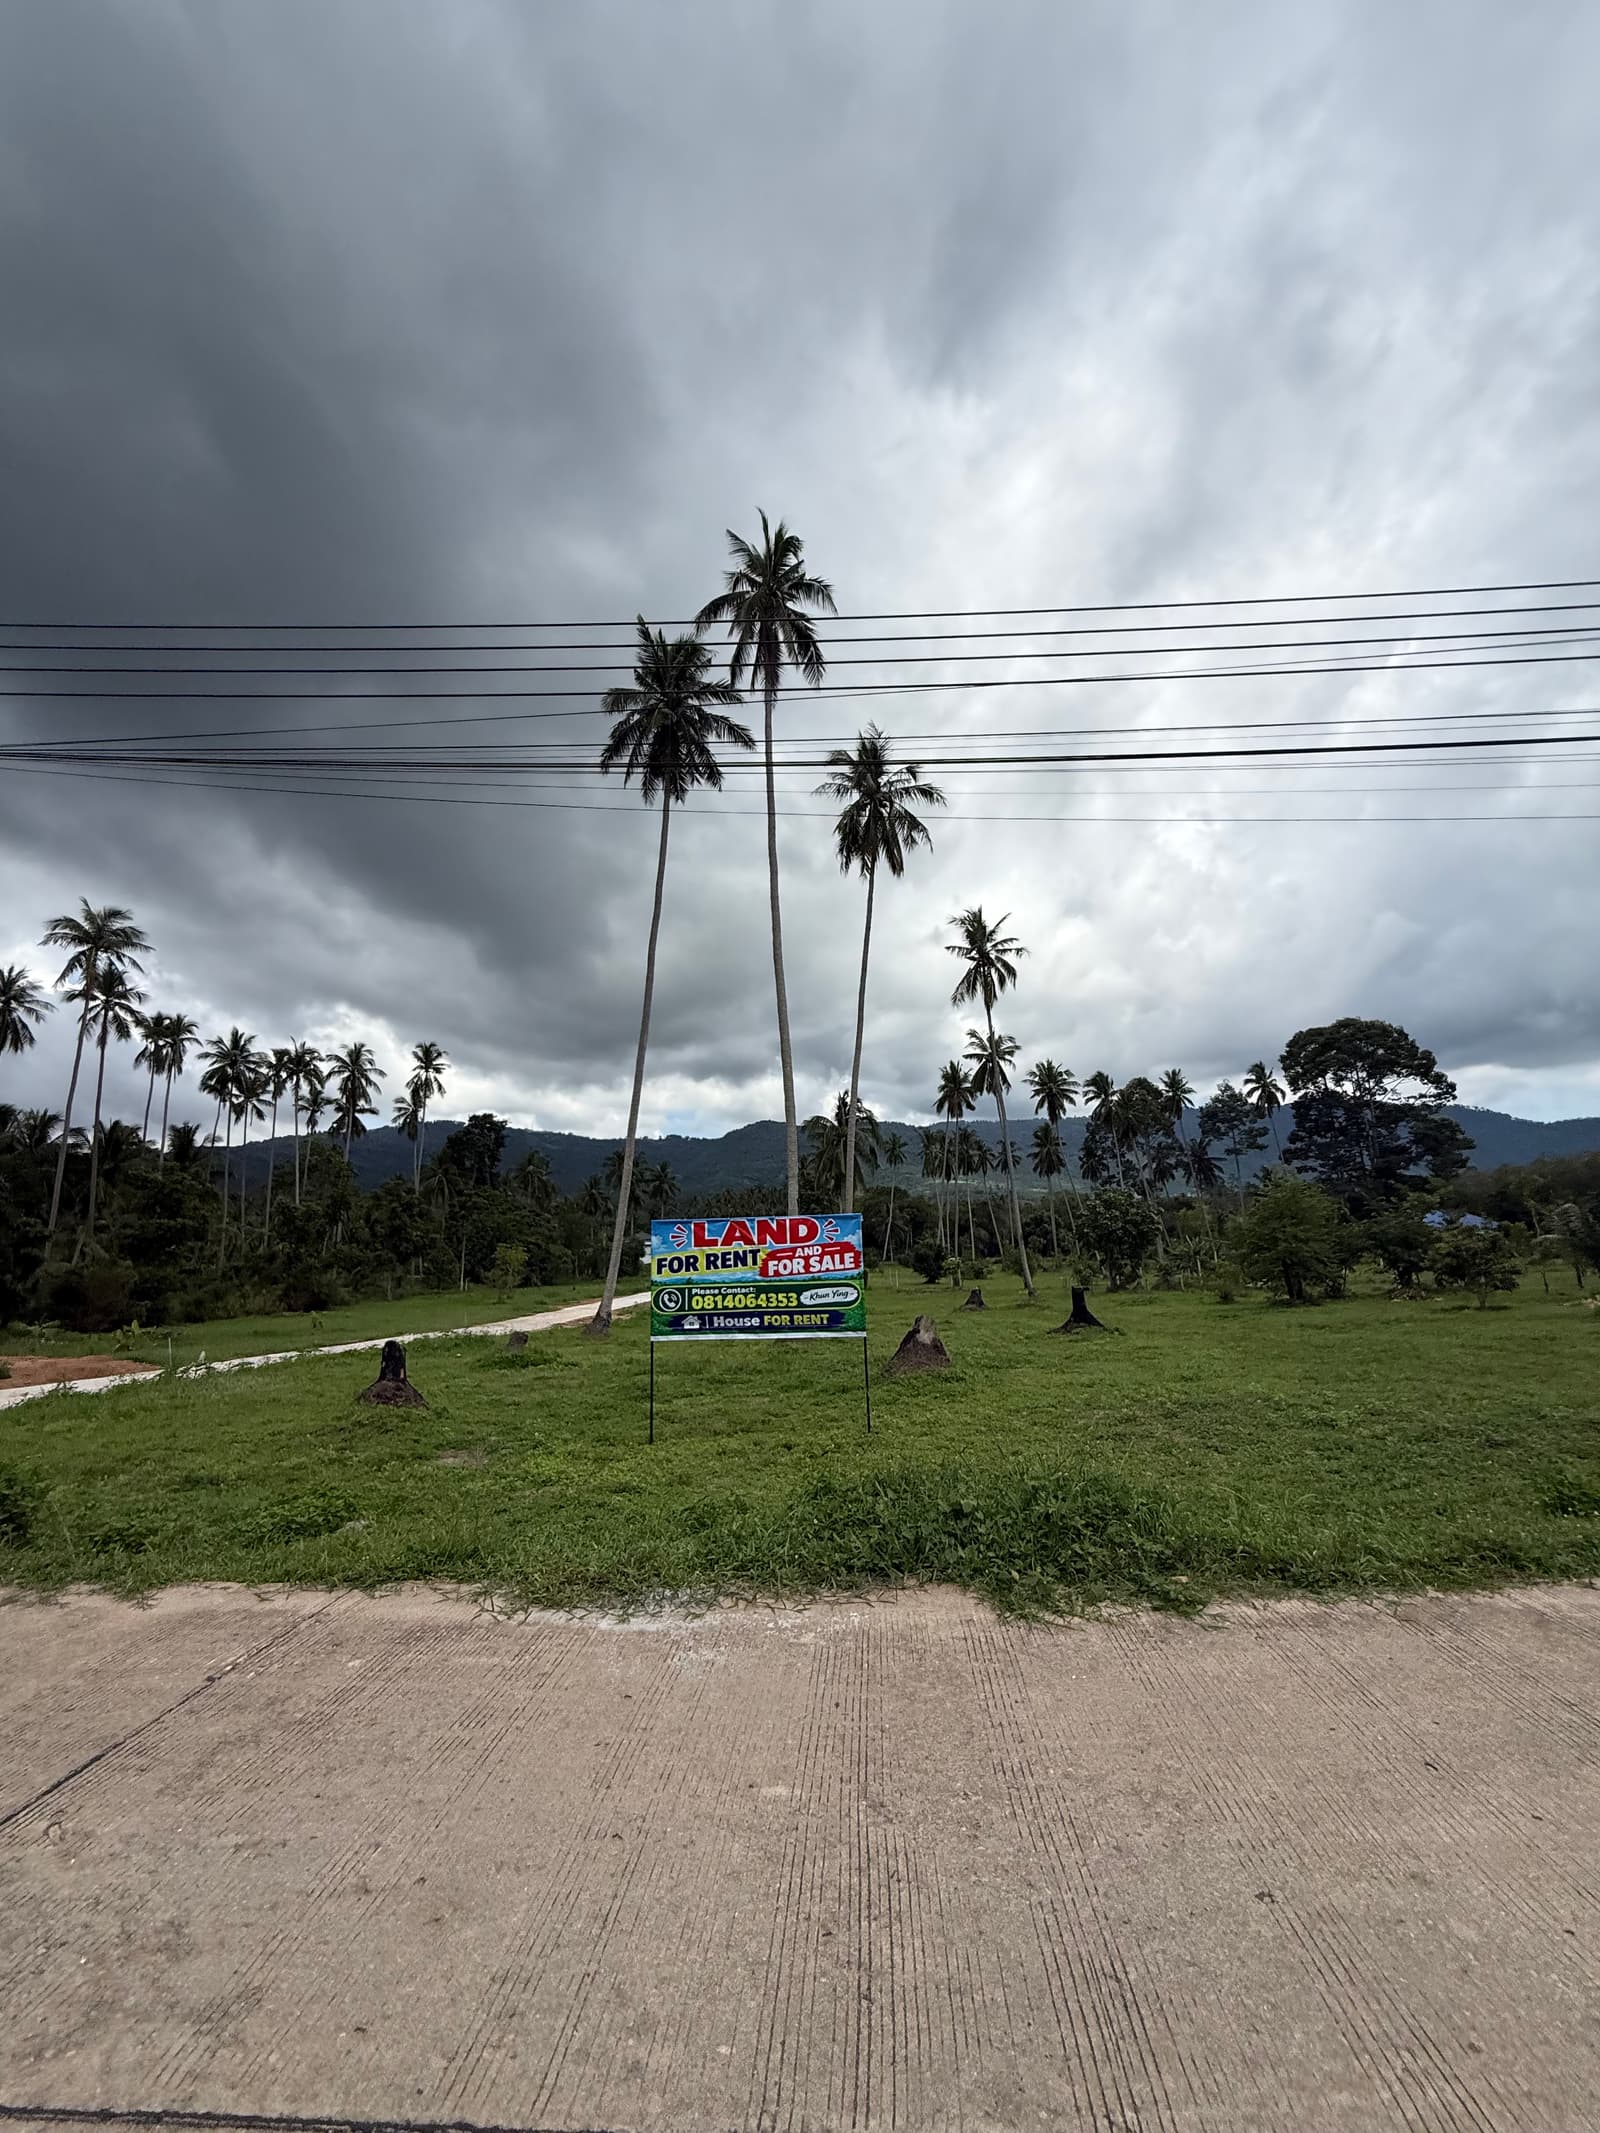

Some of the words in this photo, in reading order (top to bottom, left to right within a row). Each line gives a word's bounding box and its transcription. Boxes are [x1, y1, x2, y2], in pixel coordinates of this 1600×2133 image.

[692, 1217, 820, 1248] LAND
[795, 1246, 822, 1257] AND
[657, 1257, 699, 1275] FOR
[706, 1249, 760, 1270] RENT
[768, 1258, 805, 1275] FOR
[810, 1253, 855, 1272] SALE
[692, 1293, 798, 1309] 0814064353
[809, 1292, 830, 1301] Khun
[832, 1290, 849, 1300] Ying
[713, 1316, 760, 1327] House
[764, 1315, 790, 1326] FOR
[794, 1314, 829, 1325] RENT
